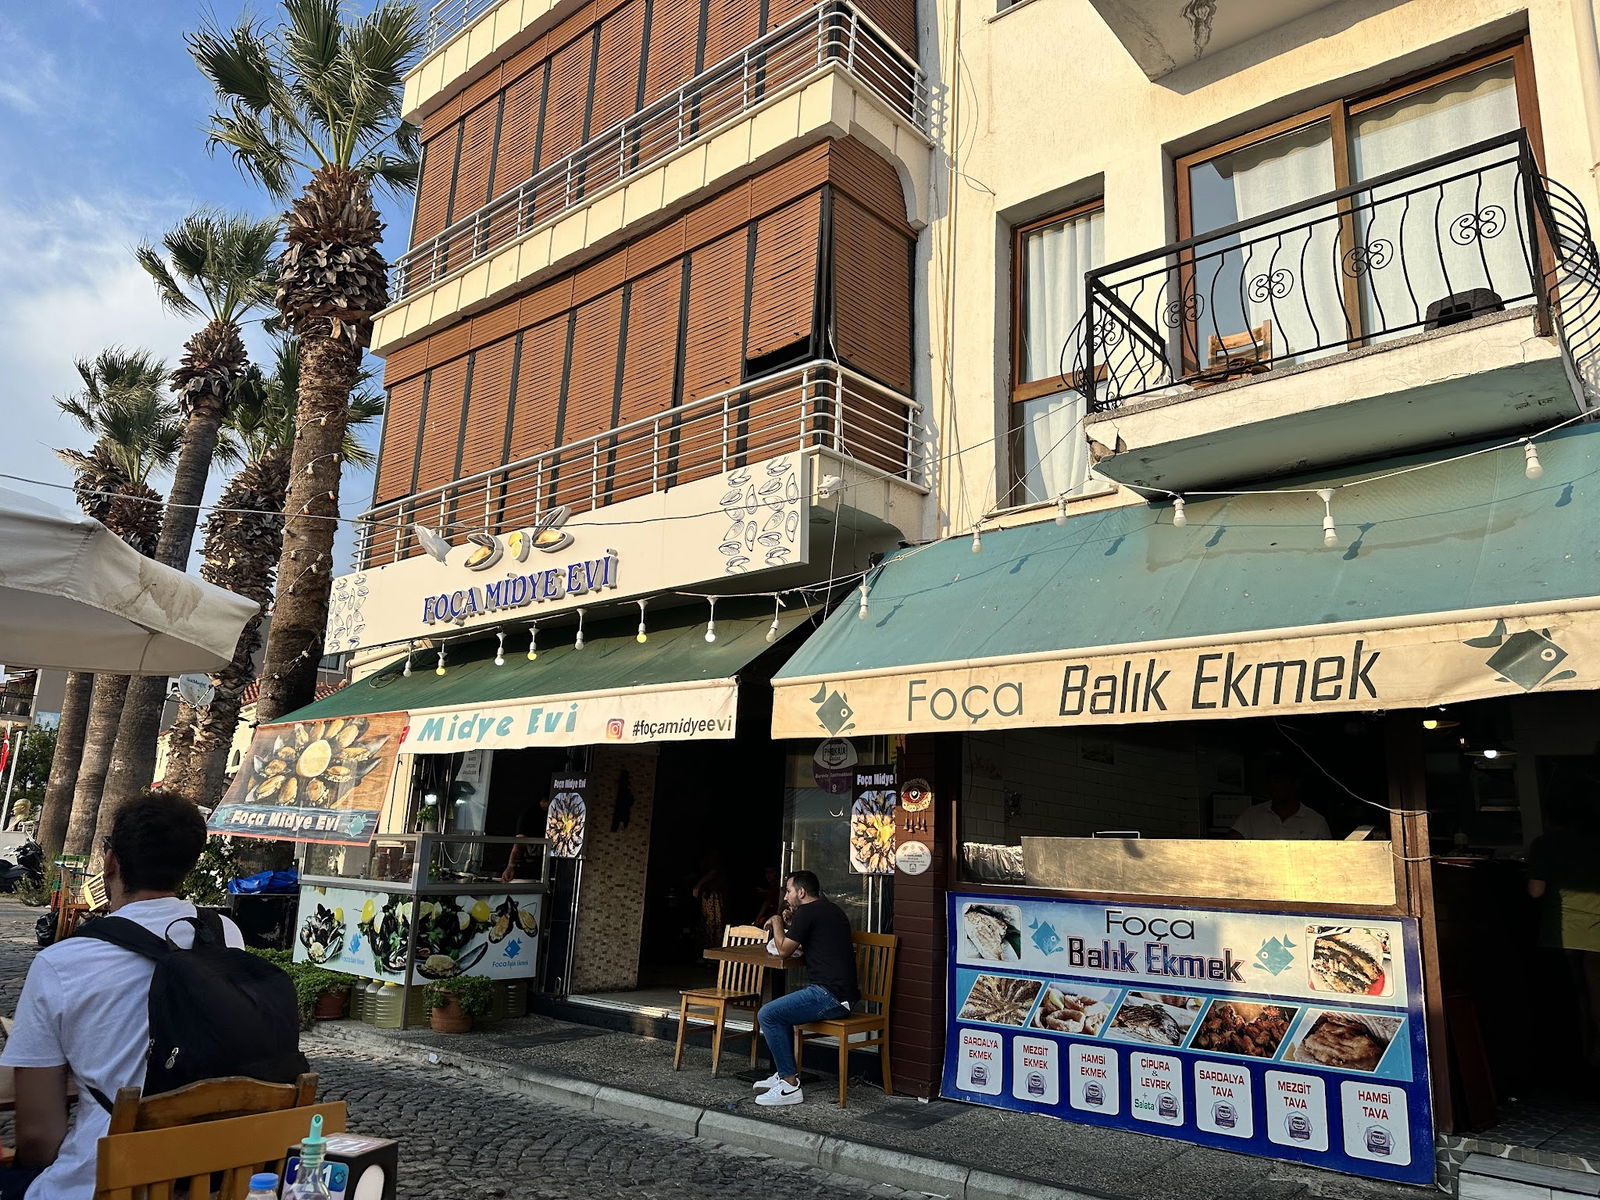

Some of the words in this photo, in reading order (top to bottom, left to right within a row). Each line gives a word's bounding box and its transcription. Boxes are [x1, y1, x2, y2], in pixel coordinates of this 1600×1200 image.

[422, 587, 483, 626] FOÇA
[484, 569, 563, 609] MİDYE
[566, 548, 618, 596] EVİ
[907, 679, 1024, 725] Foça
[1059, 658, 1172, 716] Balık
[1191, 640, 1381, 710] Ekmek
[417, 712, 514, 743] Midye
[526, 702, 579, 736] Evi
[632, 715, 733, 738] #foçamidyeevi
[856, 774, 873, 788] Foça
[873, 772, 894, 787] Midye
[231, 809, 266, 828] Foça
[267, 811, 312, 832] Midye
[315, 815, 340, 832] Evi
[1105, 909, 1195, 942] Foça
[1067, 936, 1139, 973] Balık
[1144, 941, 1246, 984] Ekmek
[963, 1036, 999, 1049] SARDALYA
[968, 1049, 993, 1061] EKMEK
[1022, 1044, 1049, 1057] MEZGİT
[1023, 1058, 1048, 1070] EKMEK
[1081, 1053, 1106, 1065] HAMSİ
[1140, 1057, 1170, 1072] ÇİPURA
[1080, 1067, 1107, 1079] EKMEK
[1199, 1069, 1245, 1086] SARDALYA
[1140, 1077, 1172, 1091] LEVREK
[1277, 1080, 1312, 1095] MEZGİT
[1211, 1086, 1234, 1099] TAVA
[1358, 1090, 1391, 1105] HAMSİ
[1134, 1098, 1155, 1111] Salata
[1283, 1096, 1308, 1110] TAVA
[1363, 1106, 1389, 1120] TAVA
